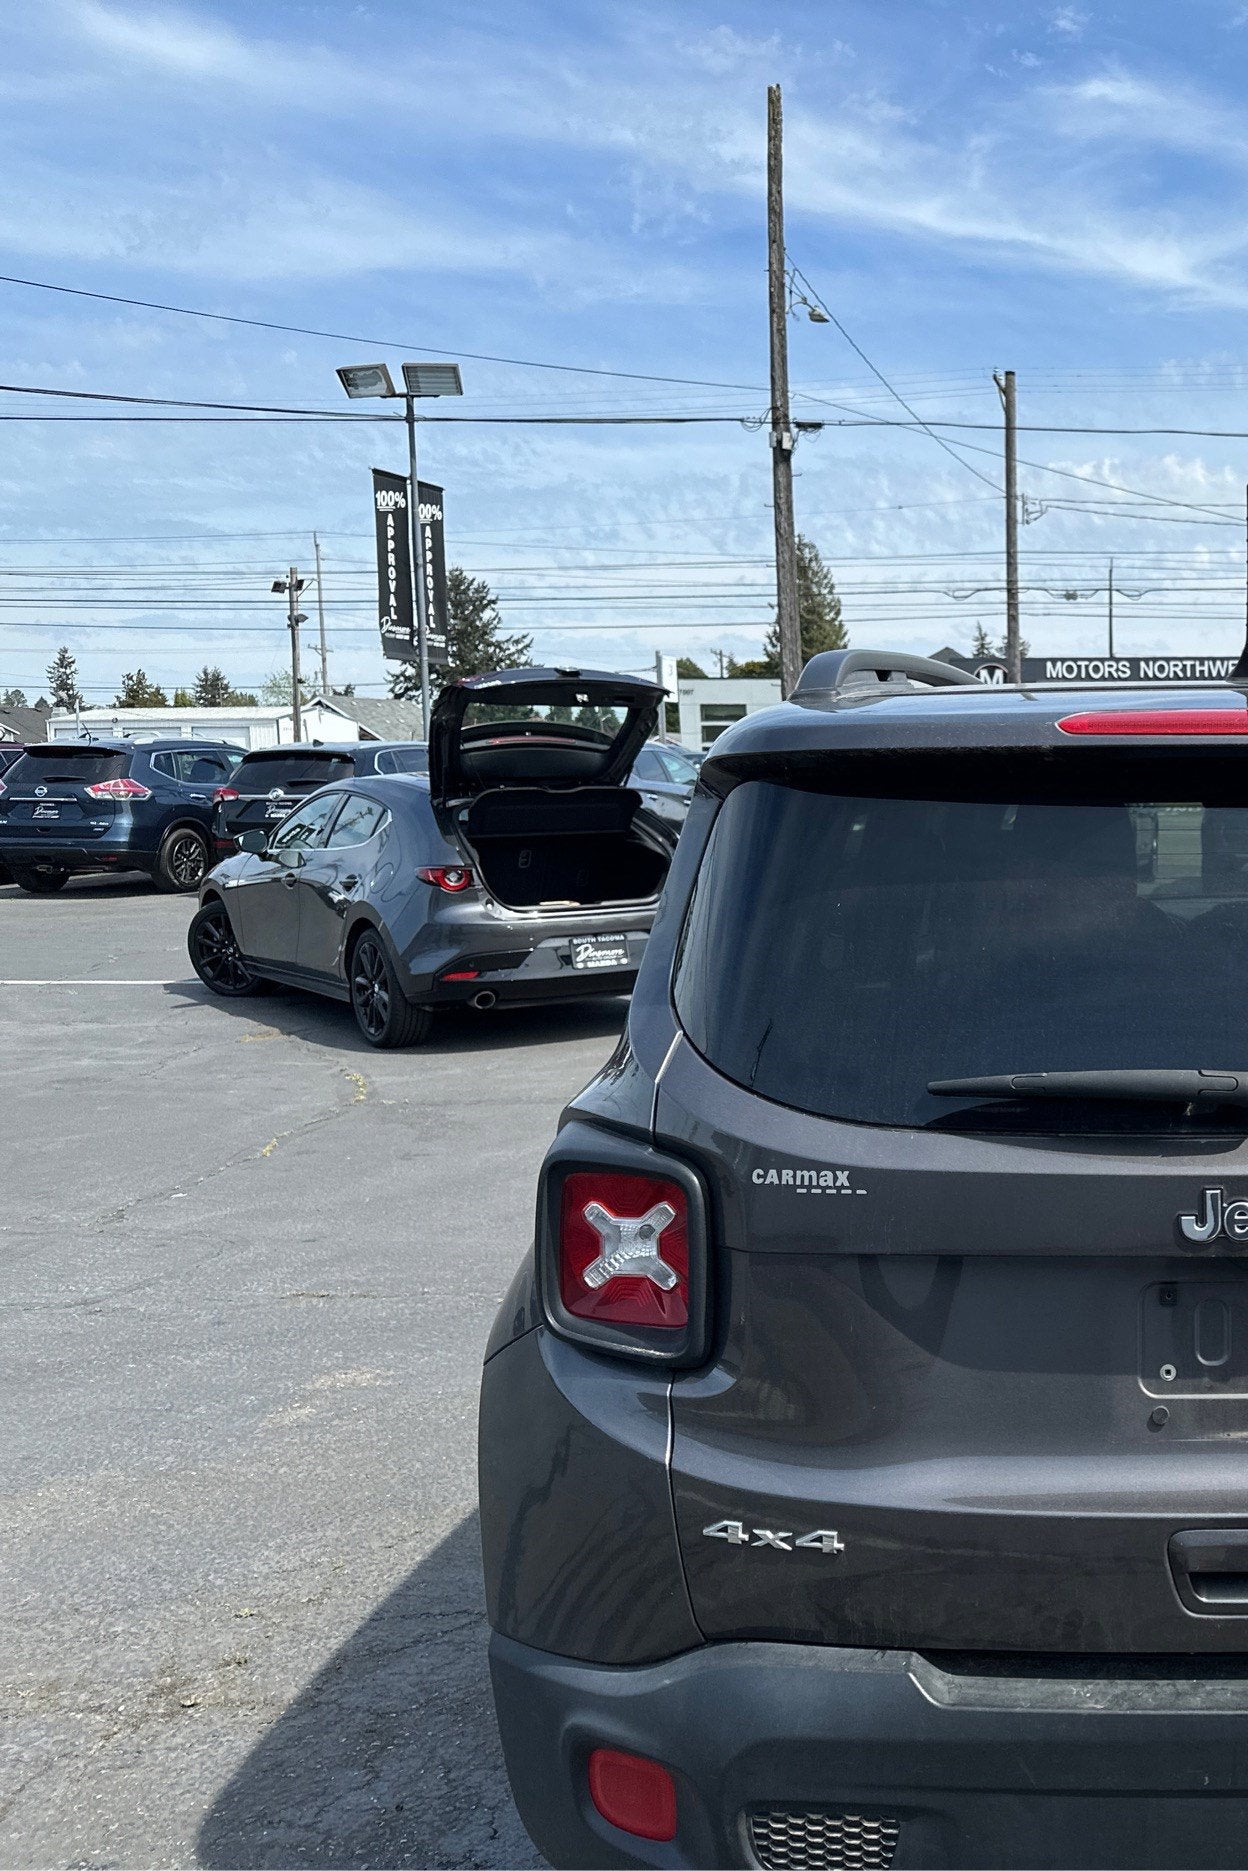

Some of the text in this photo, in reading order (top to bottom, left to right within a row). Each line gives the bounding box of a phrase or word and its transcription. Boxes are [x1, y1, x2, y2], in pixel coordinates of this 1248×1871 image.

[375, 490, 406, 509] 100%
[418, 503, 443, 521] 00%
[386, 513, 398, 620] APPROVAL
[425, 526, 436, 629] APPROVAL
[1046, 660, 1131, 679] MOTORS
[1140, 660, 1239, 679] NORTHWE
